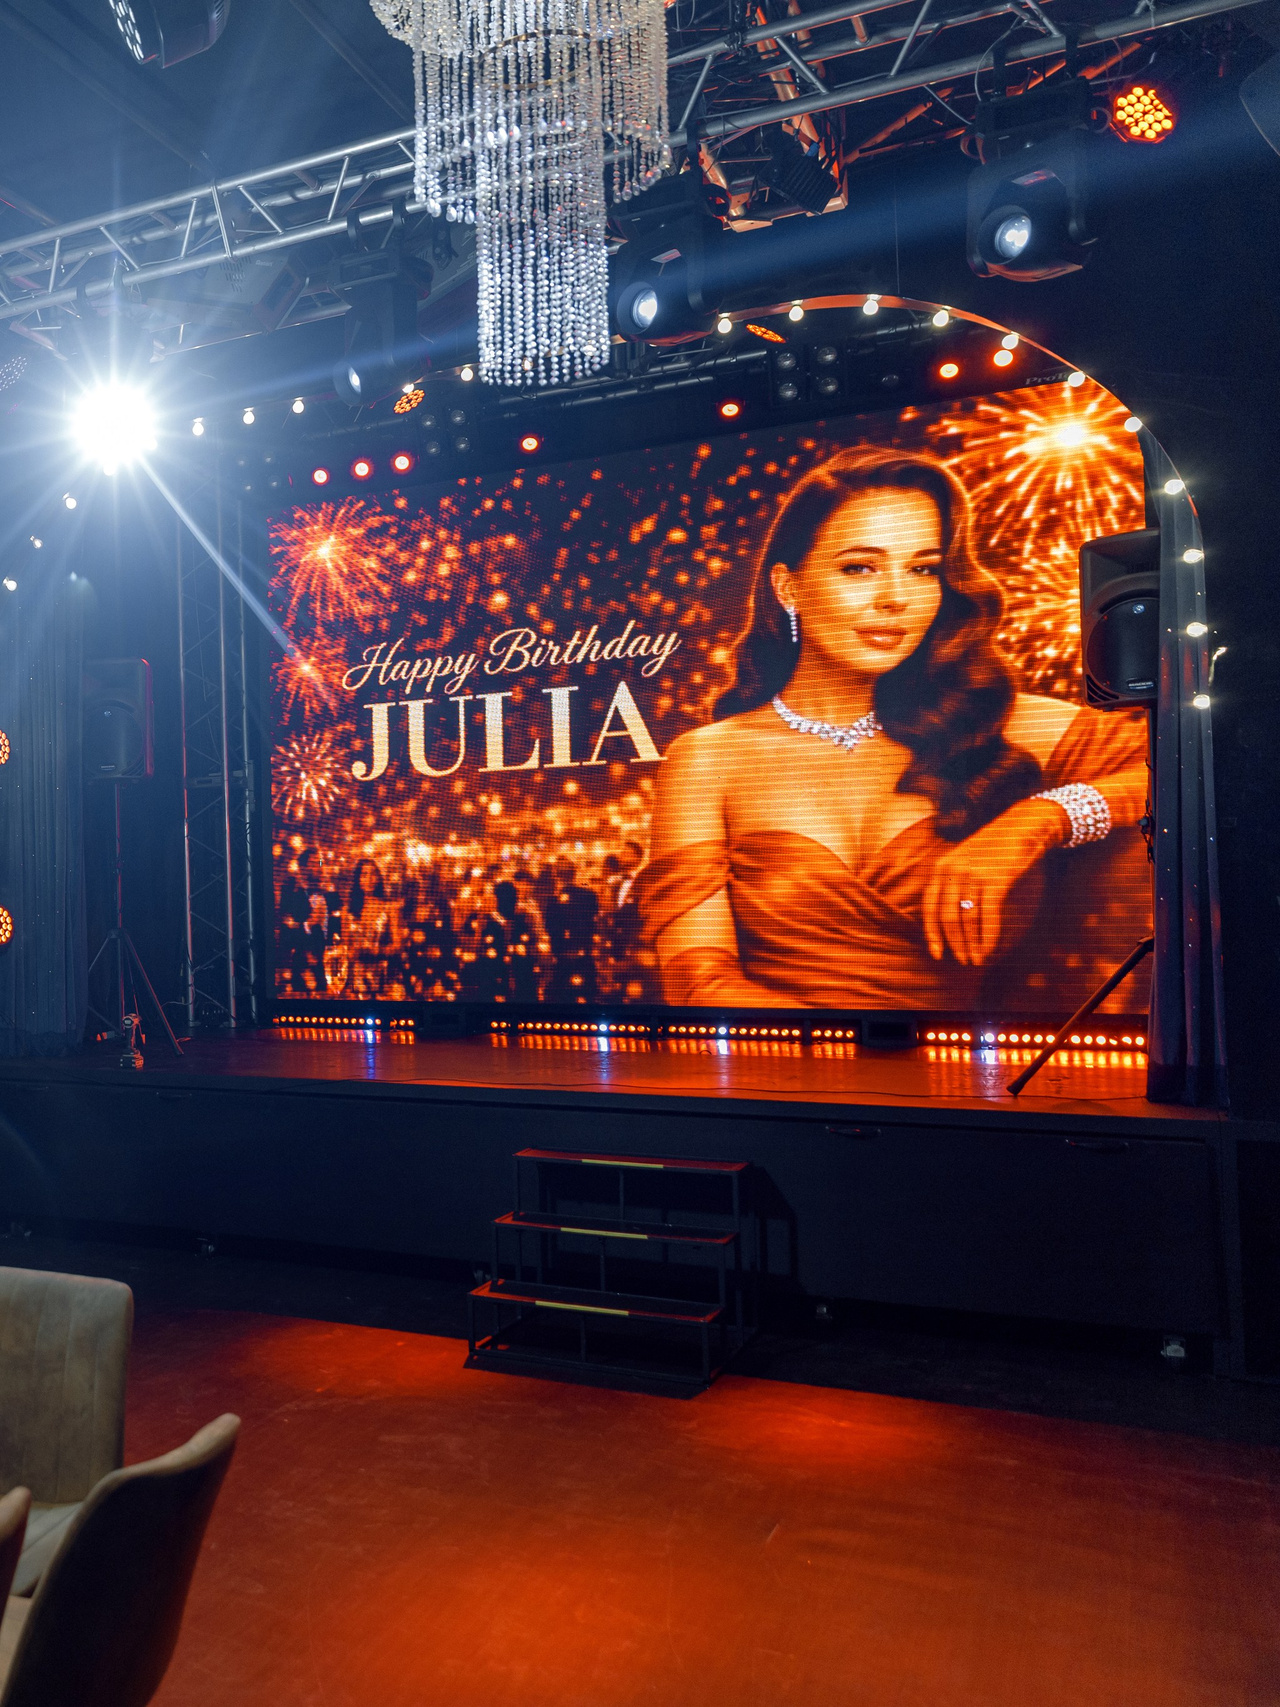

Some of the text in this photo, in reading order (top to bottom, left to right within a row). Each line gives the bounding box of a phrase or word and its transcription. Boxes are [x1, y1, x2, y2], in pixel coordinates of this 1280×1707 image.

[342, 620, 682, 695] Happy Birthday
[351, 681, 669, 782] JULIA
